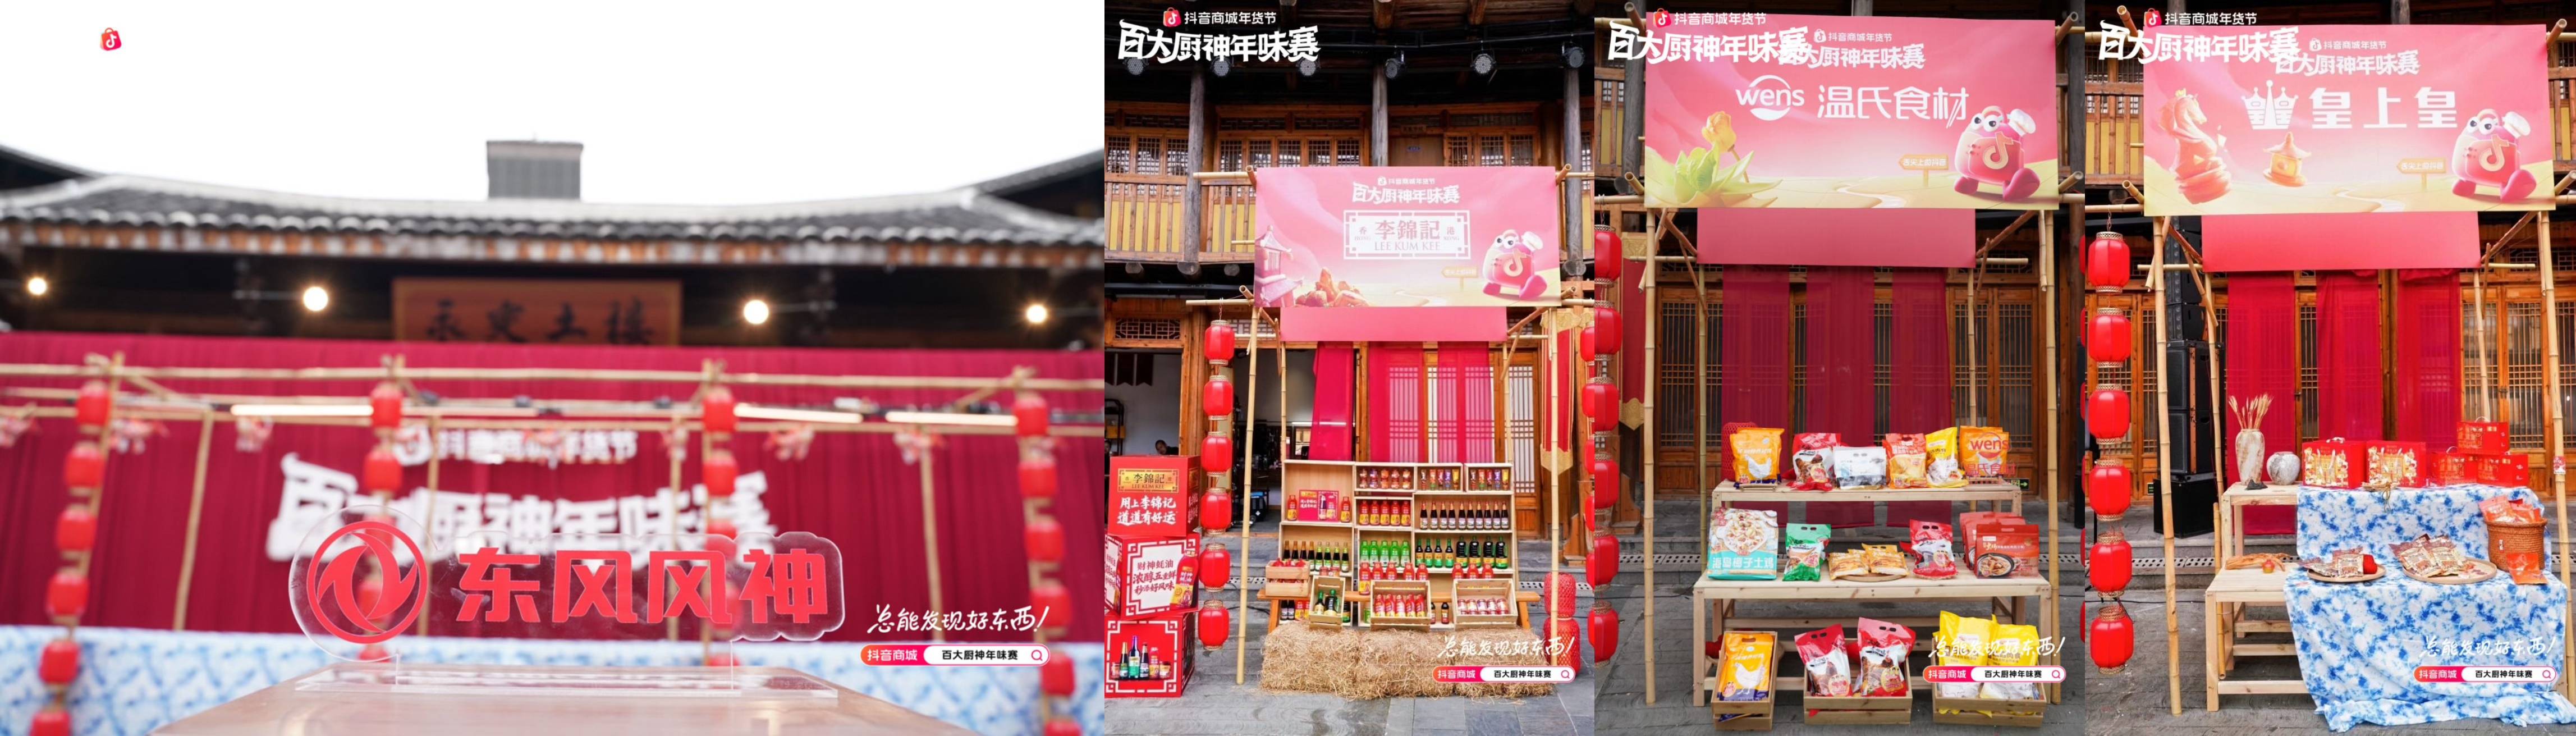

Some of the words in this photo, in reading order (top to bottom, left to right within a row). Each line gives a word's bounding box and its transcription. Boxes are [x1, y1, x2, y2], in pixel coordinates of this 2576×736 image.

[1828, 33, 1892, 42] 抖音商城年货节
[2323, 40, 2387, 50] 抖音商城年货节
[1779, 42, 1926, 69] 大厨神年味赛
[1735, 88, 1805, 107] wens
[1818, 85, 1969, 129] 温氏食材
[2308, 86, 2458, 129] 皇上皇
[1352, 182, 1461, 204] 百大厨神年味赛
[1375, 220, 1440, 240] 李錦記
[1375, 242, 1391, 250] LEE
[1395, 242, 1419, 250] KUM
[1422, 242, 1440, 250] KEE
[1970, 439, 2011, 450] wens
[1133, 473, 1165, 483] 李錦記
[1120, 495, 1176, 510] 用上李锦记
[1117, 510, 1176, 526] 道道有好运
[1137, 560, 1174, 570] 财神蚝油
[456, 547, 828, 624] 东风风神
